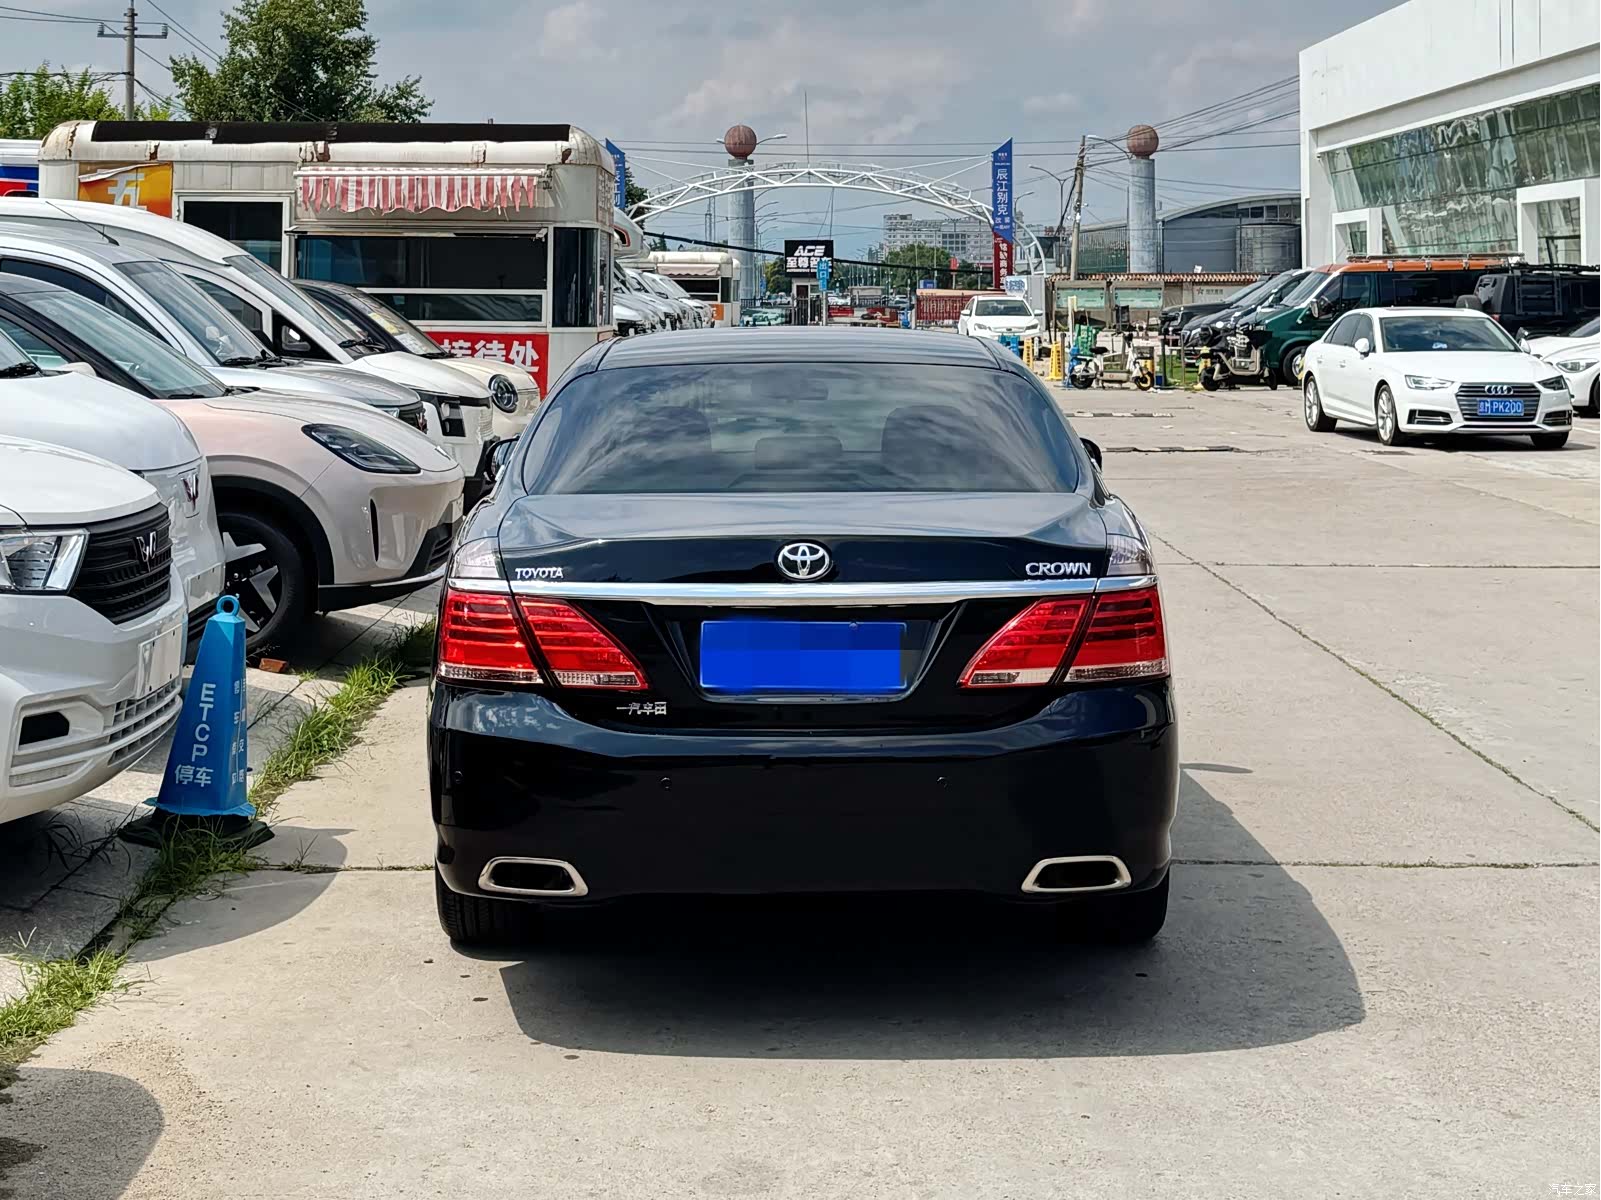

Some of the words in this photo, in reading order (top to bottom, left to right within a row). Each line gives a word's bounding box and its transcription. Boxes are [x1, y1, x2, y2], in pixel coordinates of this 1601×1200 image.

[997, 169, 1009, 215] 辰江别克
[793, 245, 826, 256] ACE
[440, 339, 540, 372] 接待处
[515, 567, 564, 580] TOYOTA
[1025, 562, 1092, 576] CROWN
[191, 682, 217, 762] ETCP
[174, 764, 215, 788] 停车
